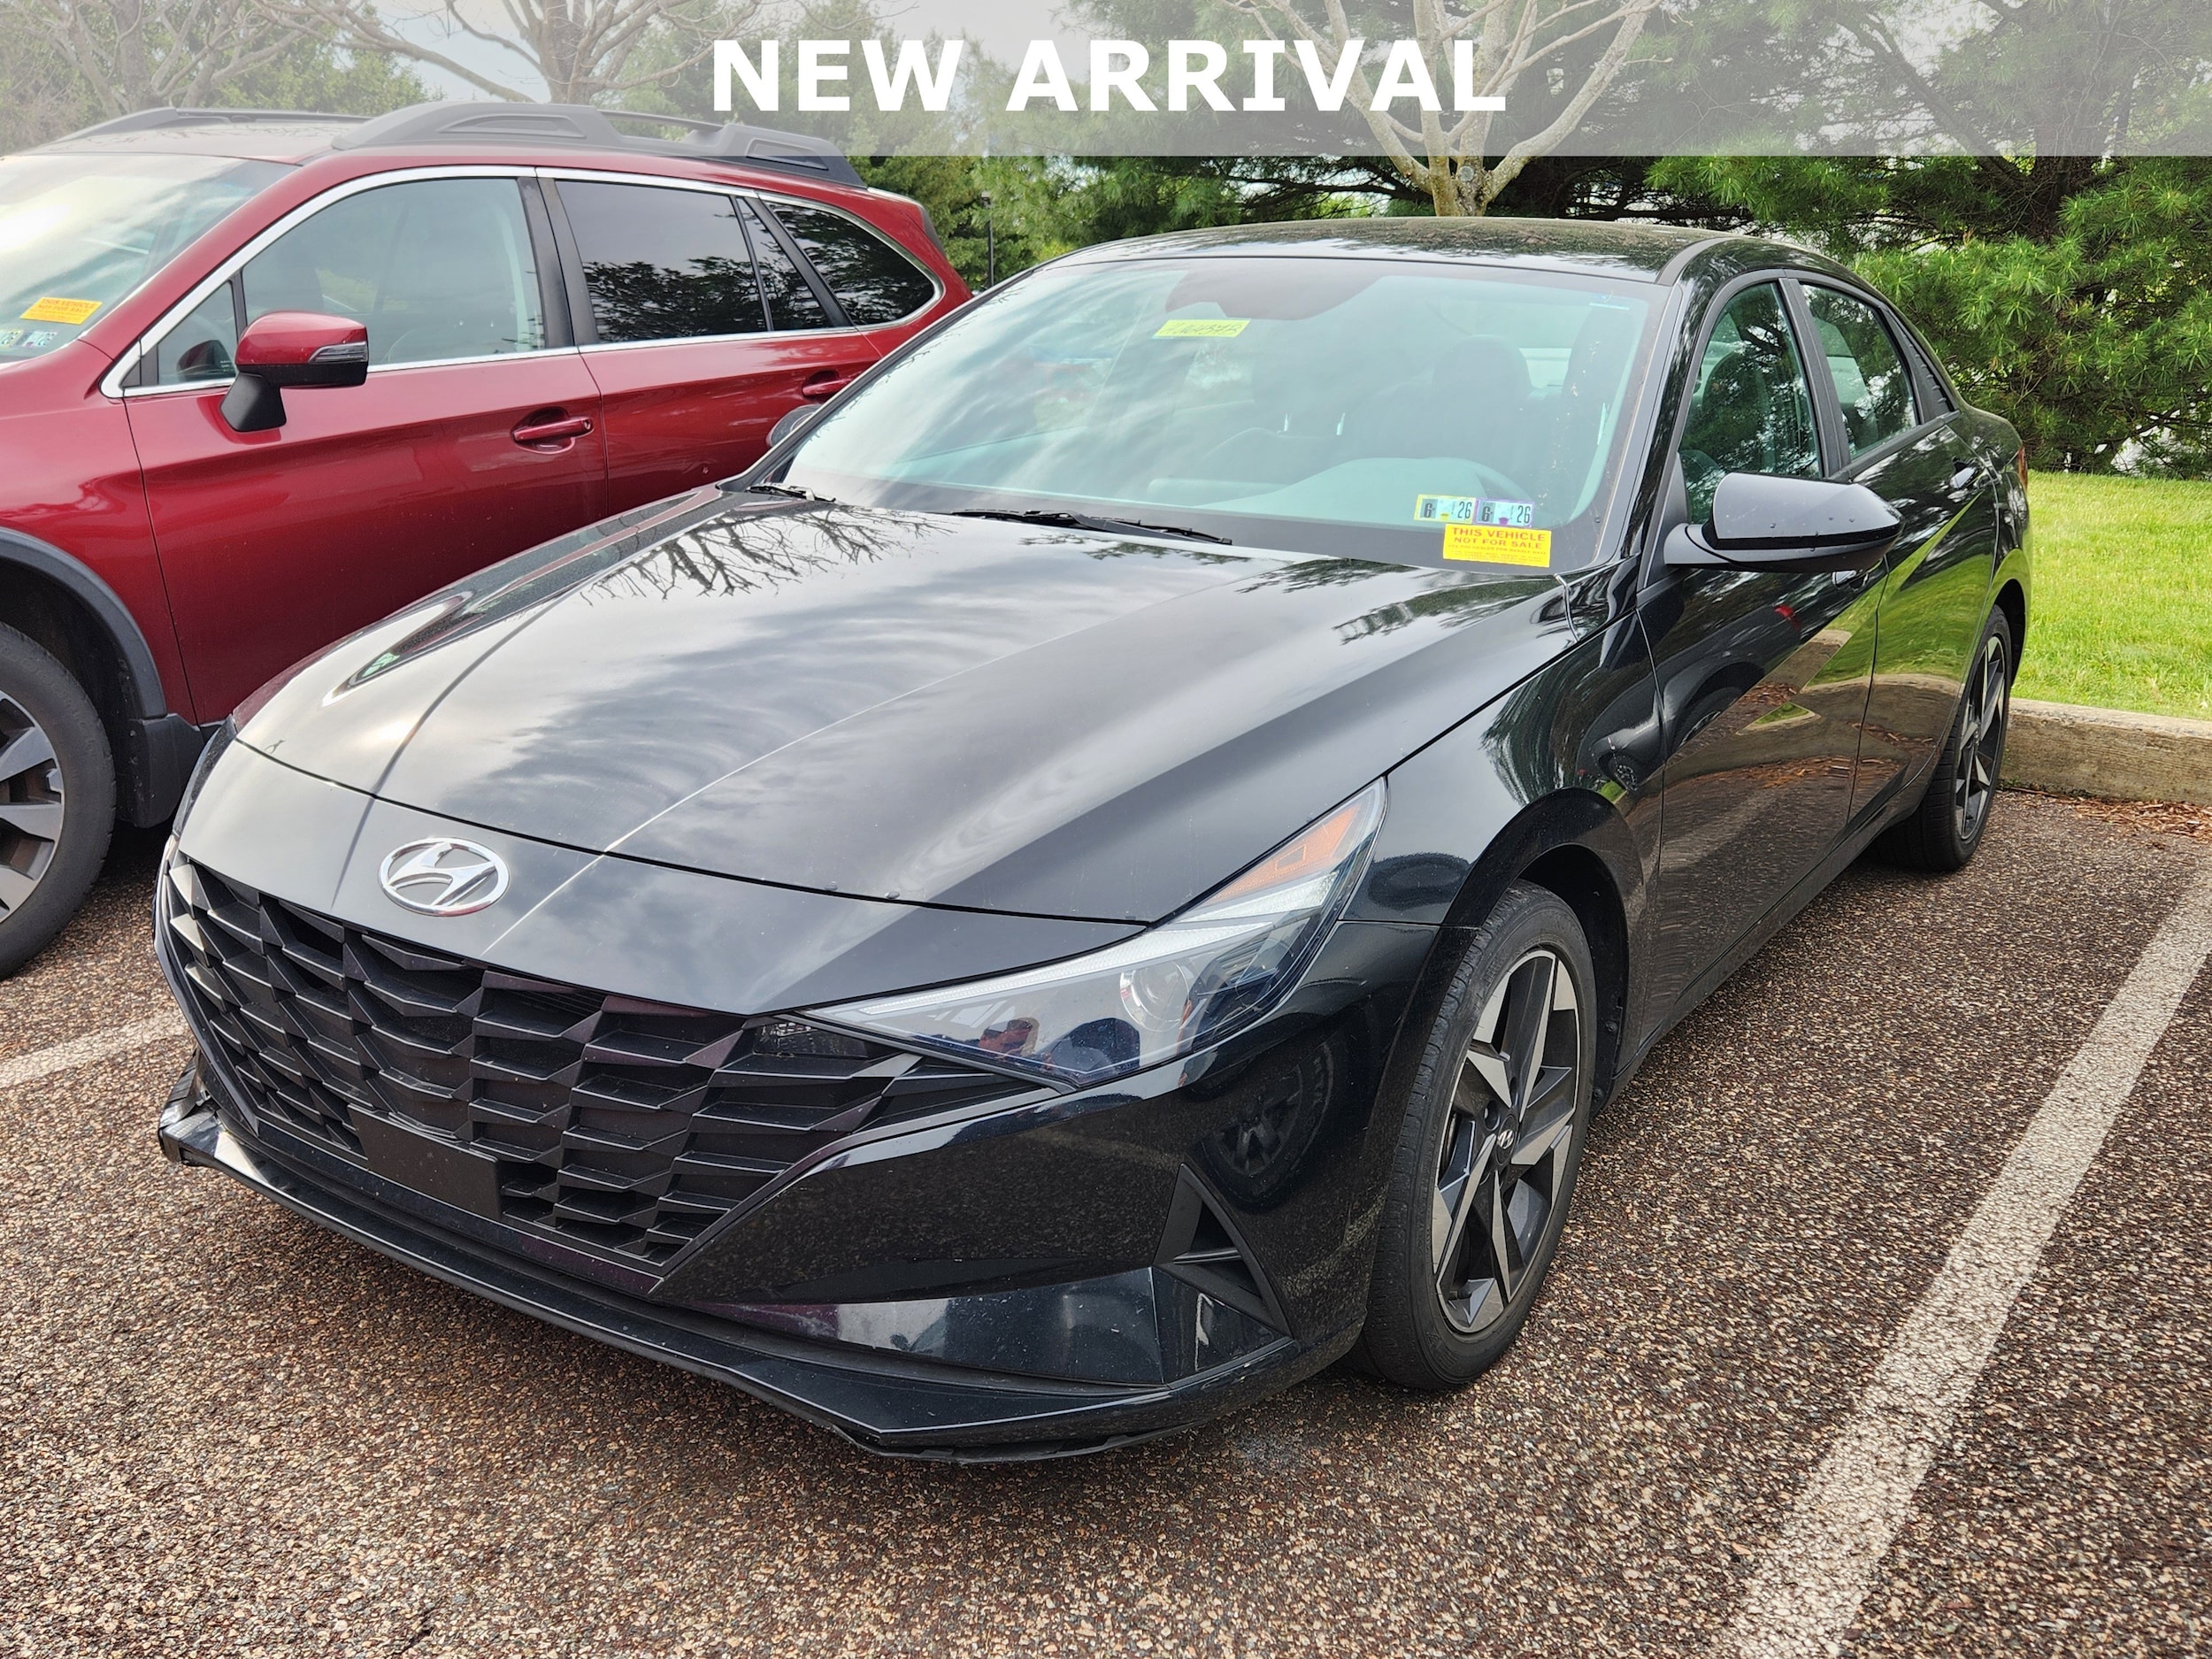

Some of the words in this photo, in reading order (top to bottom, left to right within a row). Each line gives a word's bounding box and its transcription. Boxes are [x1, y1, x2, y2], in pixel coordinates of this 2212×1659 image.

[1424, 503, 1432, 518] 6
[1457, 501, 1472, 519] 26
[1481, 506, 1491, 522] 6
[1517, 505, 1532, 524] 26
[1452, 527, 1483, 537] THIS
[1486, 530, 1547, 541] VEHICLE
[1510, 541, 1543, 549] SALE
